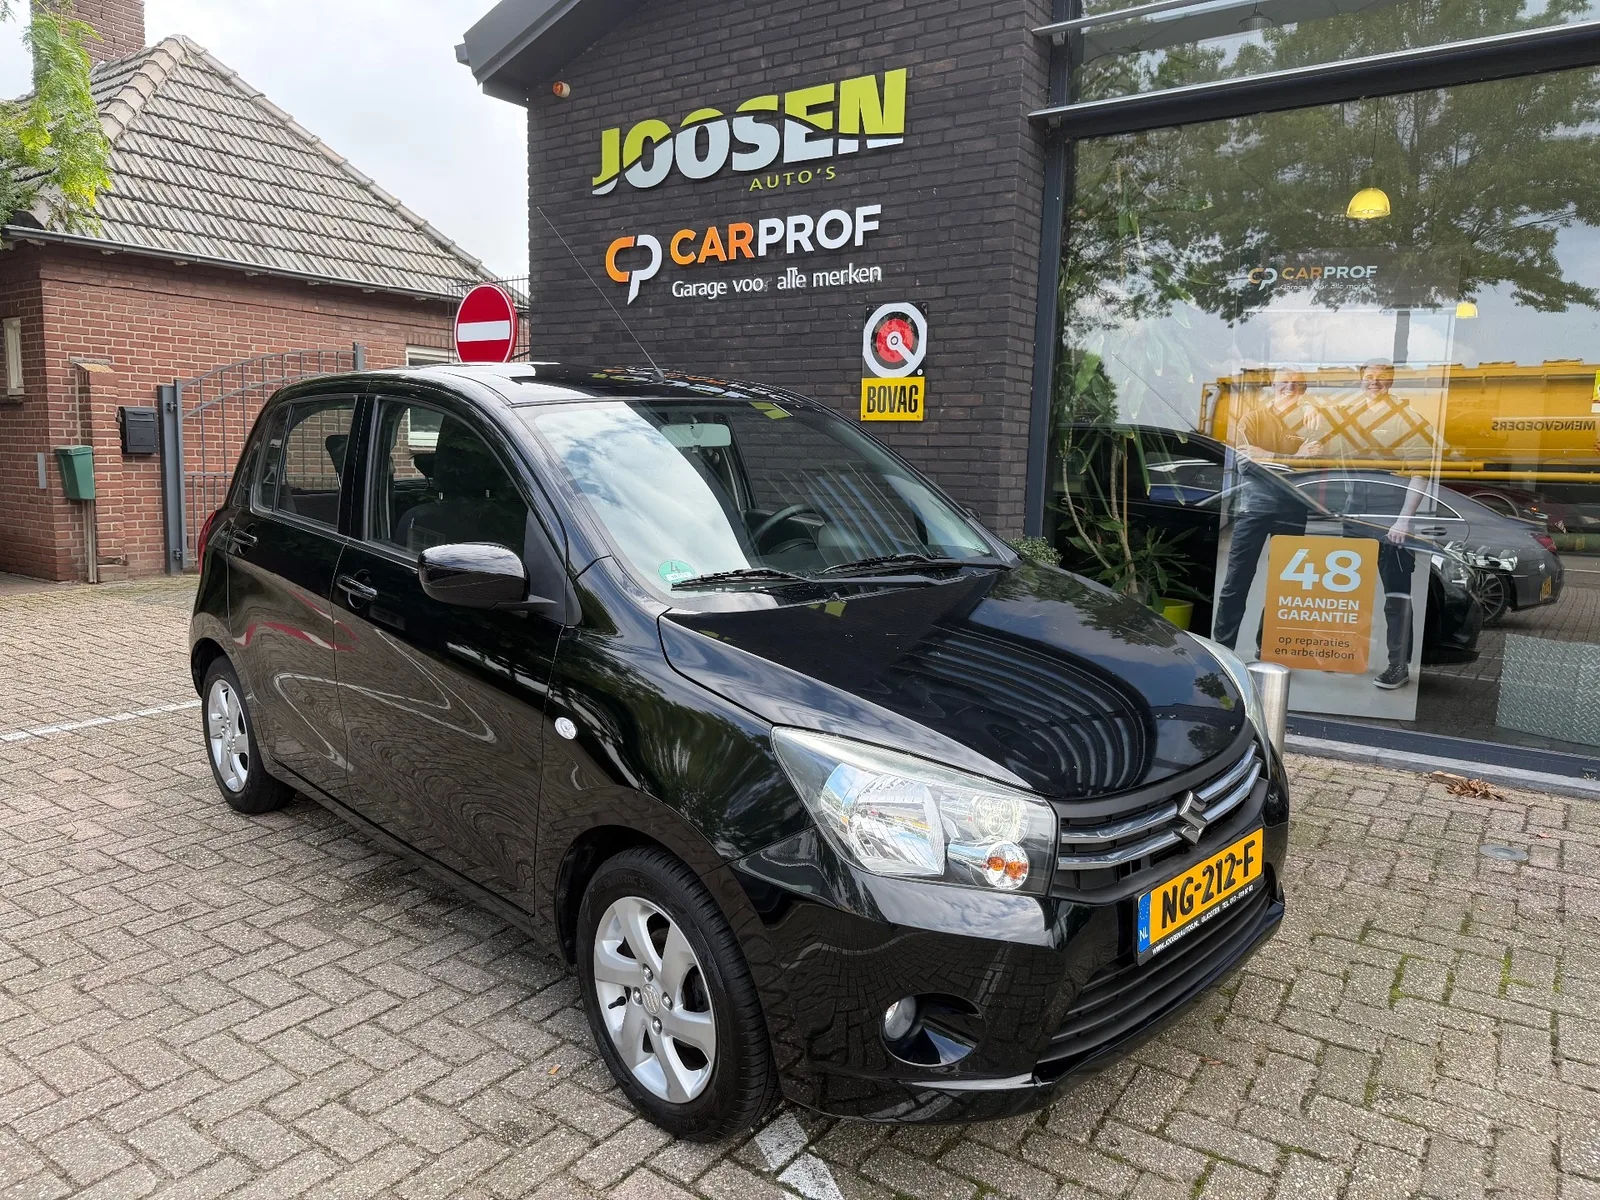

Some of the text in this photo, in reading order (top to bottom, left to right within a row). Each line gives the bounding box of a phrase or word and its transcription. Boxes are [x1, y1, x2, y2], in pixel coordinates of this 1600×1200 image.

[592, 68, 907, 195] JOOSEN
[749, 166, 837, 192] AUTO'S
[670, 204, 882, 265] CARPROF
[672, 280, 727, 299] Garage
[812, 262, 882, 288] merken
[1281, 265, 1378, 280] CARPROF
[867, 385, 919, 413] BOVAG
[1280, 548, 1362, 592] 48
[1277, 609, 1358, 624] GARANTIE
[1278, 596, 1360, 611] MAANDEN
[1278, 637, 1350, 648] op reparaties
[1291, 647, 1355, 660] arbeidsloon
[1162, 840, 1255, 929] NG-212-F
[1140, 926, 1148, 942] NL
